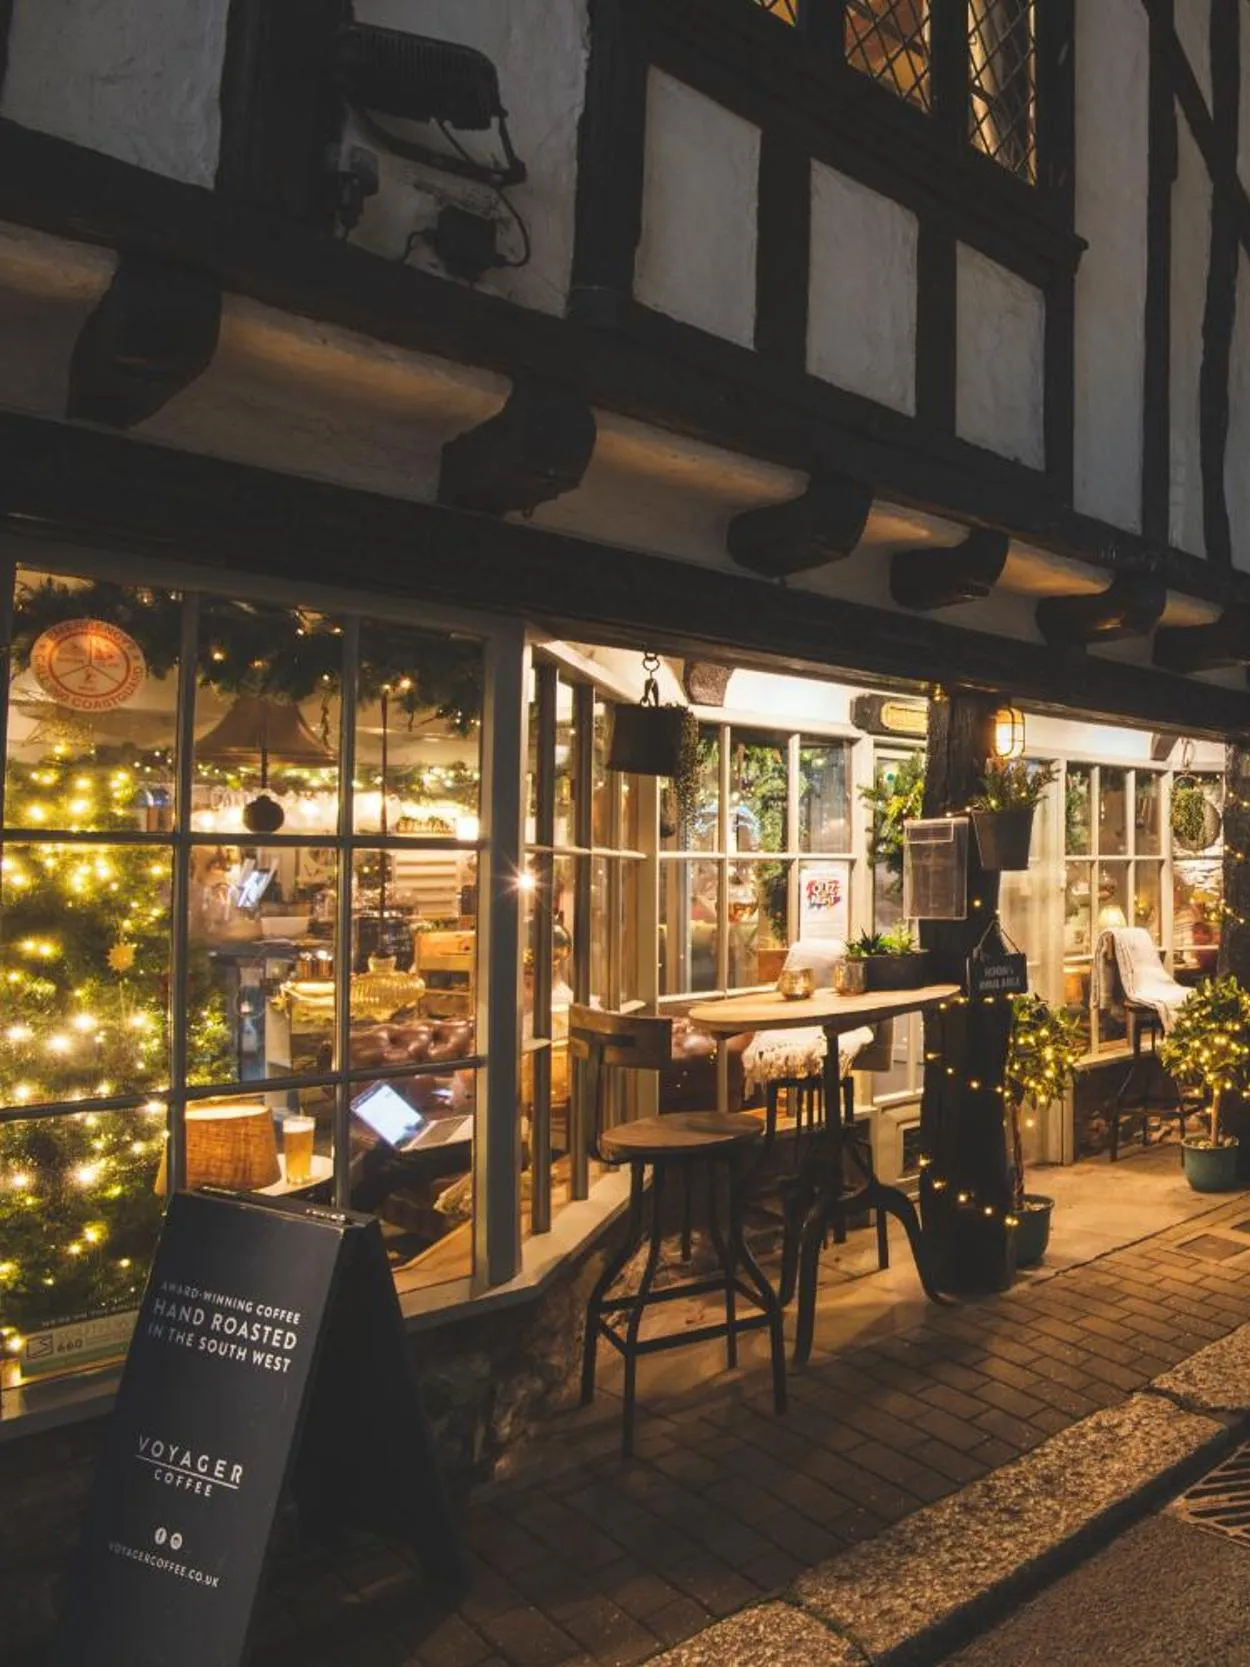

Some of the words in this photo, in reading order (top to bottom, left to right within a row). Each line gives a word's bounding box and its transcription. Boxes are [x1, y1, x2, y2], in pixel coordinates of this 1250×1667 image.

[153, 1300, 205, 1327] HAND
[211, 1314, 298, 1351] ROASTED
[161, 1281, 253, 1315] AWARD-WINNING
[256, 1304, 301, 1326] COFFEE
[148, 1321, 163, 1338] IN
[167, 1327, 194, 1348] THE
[199, 1335, 247, 1362] SOUTH
[252, 1350, 291, 1374] WEST
[138, 1434, 244, 1484] VOYAGER
[154, 1468, 213, 1498] COFFEE
[108, 1540, 220, 1588] VOYAGERCOFFEE.CO.UK
